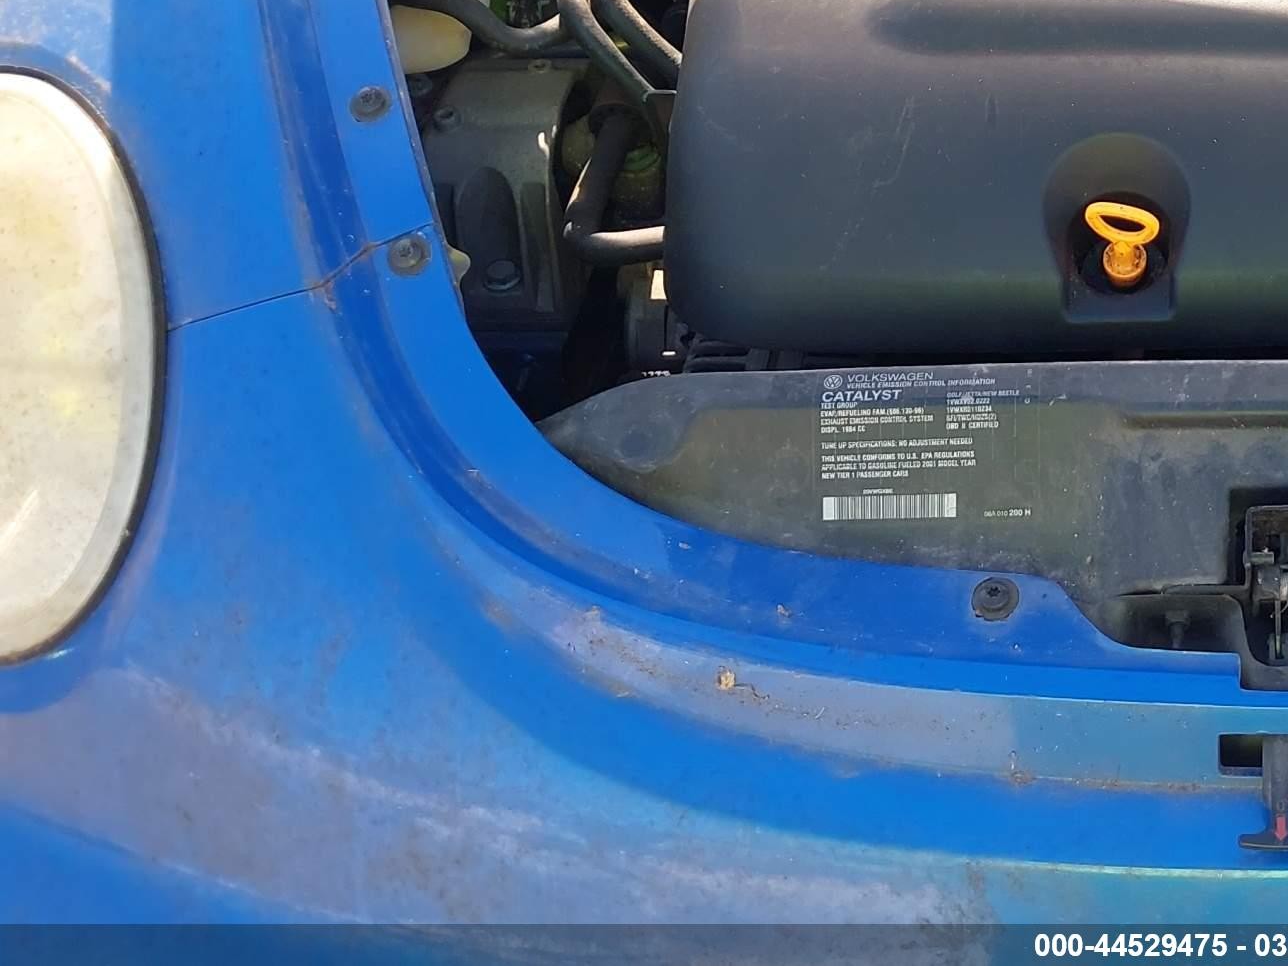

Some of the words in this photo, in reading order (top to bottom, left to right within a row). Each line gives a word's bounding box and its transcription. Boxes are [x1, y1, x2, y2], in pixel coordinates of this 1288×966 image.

[847, 372, 934, 382] VOLKSWAGEN
[947, 378, 996, 386] INFORMATION
[821, 389, 902, 402] CATALYST
[836, 401, 858, 409] GROUP
[820, 418, 848, 426] EXHAUST
[849, 417, 879, 425] EMISSION
[879, 416, 908, 424] CONTROL
[946, 422, 959, 430] OBD
[968, 421, 999, 429] CERTIFIED
[821, 441, 837, 449] TUNE
[838, 441, 847, 449] UP
[908, 438, 949, 446] ADJUSTMENT
[950, 437, 973, 445] NEEDED
[836, 454, 861, 462] VEHICLE
[862, 453, 896, 461] CONFORMS
[921, 451, 933, 459] EPA
[934, 450, 974, 458] REGULATIONS
[821, 463, 857, 471] APPLICABLE
[859, 462, 867, 470] TO
[898, 461, 921, 469] FUELED
[922, 460, 936, 468] 2001
[938, 459, 959, 467] MODEL
[960, 458, 976, 466] YEAR
[836, 471, 850, 479] TIER
[856, 470, 891, 478] PASSENGER
[1024, 508, 1031, 516] H
